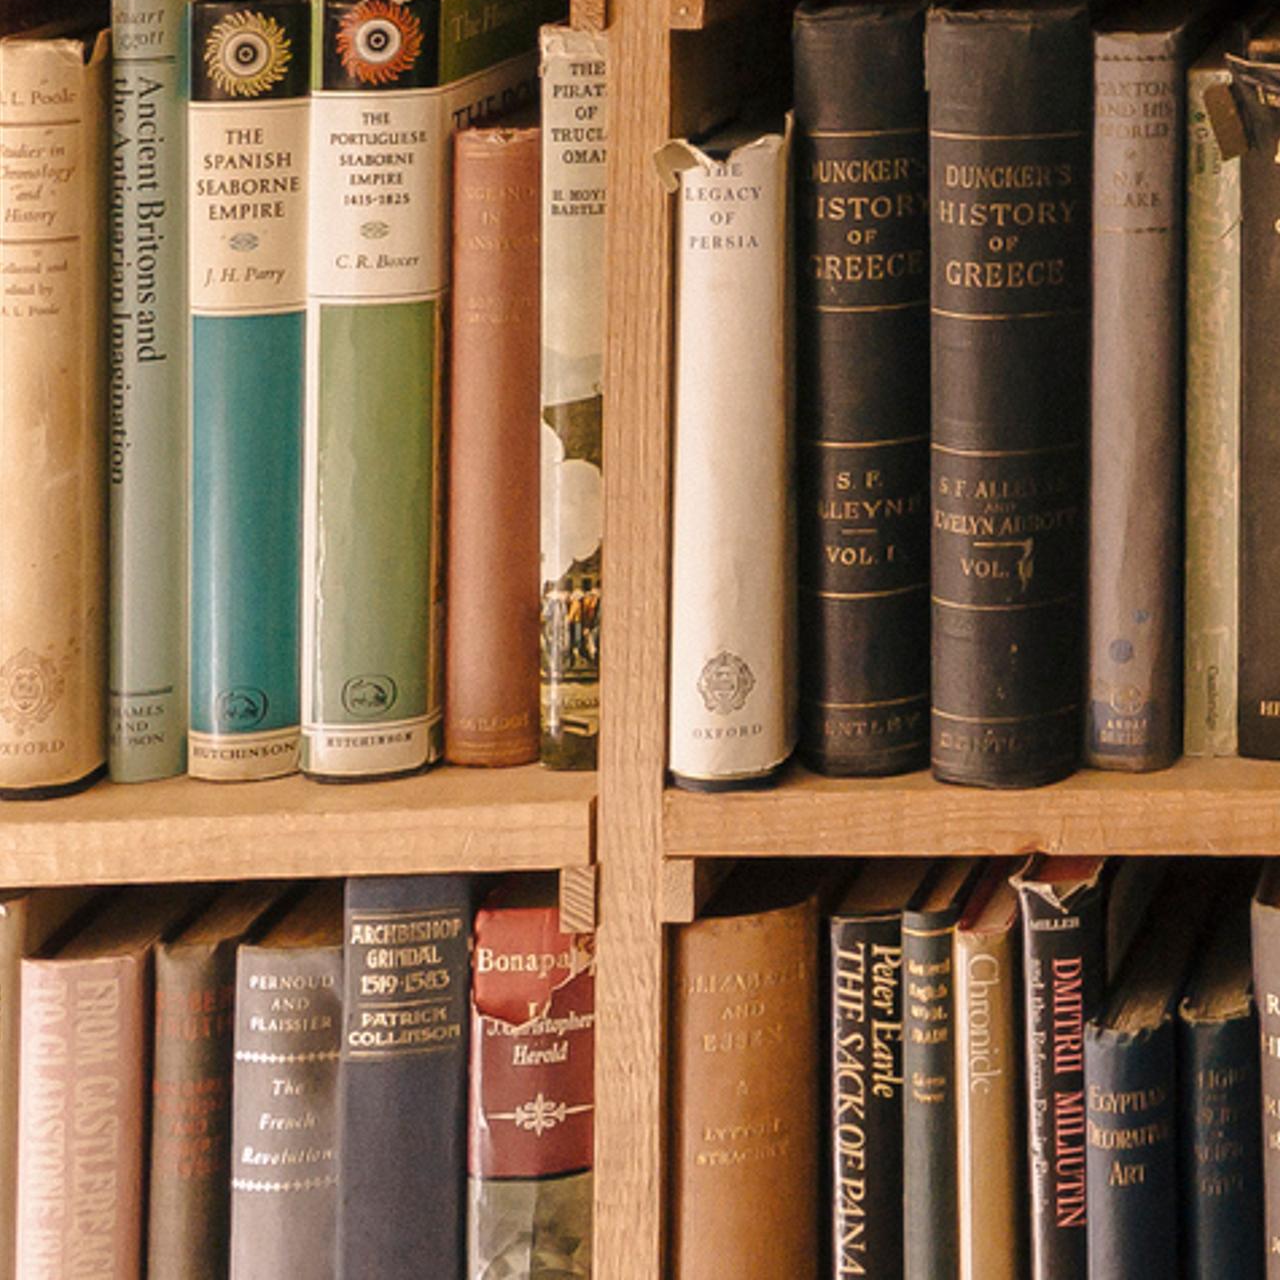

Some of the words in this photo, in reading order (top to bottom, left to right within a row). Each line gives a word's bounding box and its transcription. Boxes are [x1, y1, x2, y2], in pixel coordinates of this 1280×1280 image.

[135, 79, 165, 191] Ancient
[205, 150, 291, 170] SPANISH
[225, 129, 264, 146] THE
[197, 177, 300, 198] SEABORNE
[209, 201, 284, 221] EMPIRE
[685, 186, 763, 203] LEGACY
[137, 201, 166, 305] Britons
[690, 236, 760, 249] PERSIA
[137, 310, 166, 363] and
[870, 945, 902, 1009] Peter
[1053, 958, 1081, 1074] DMITRII
[870, 1021, 902, 1099] Earle
[1056, 1092, 1083, 1227] MILIUTIN
